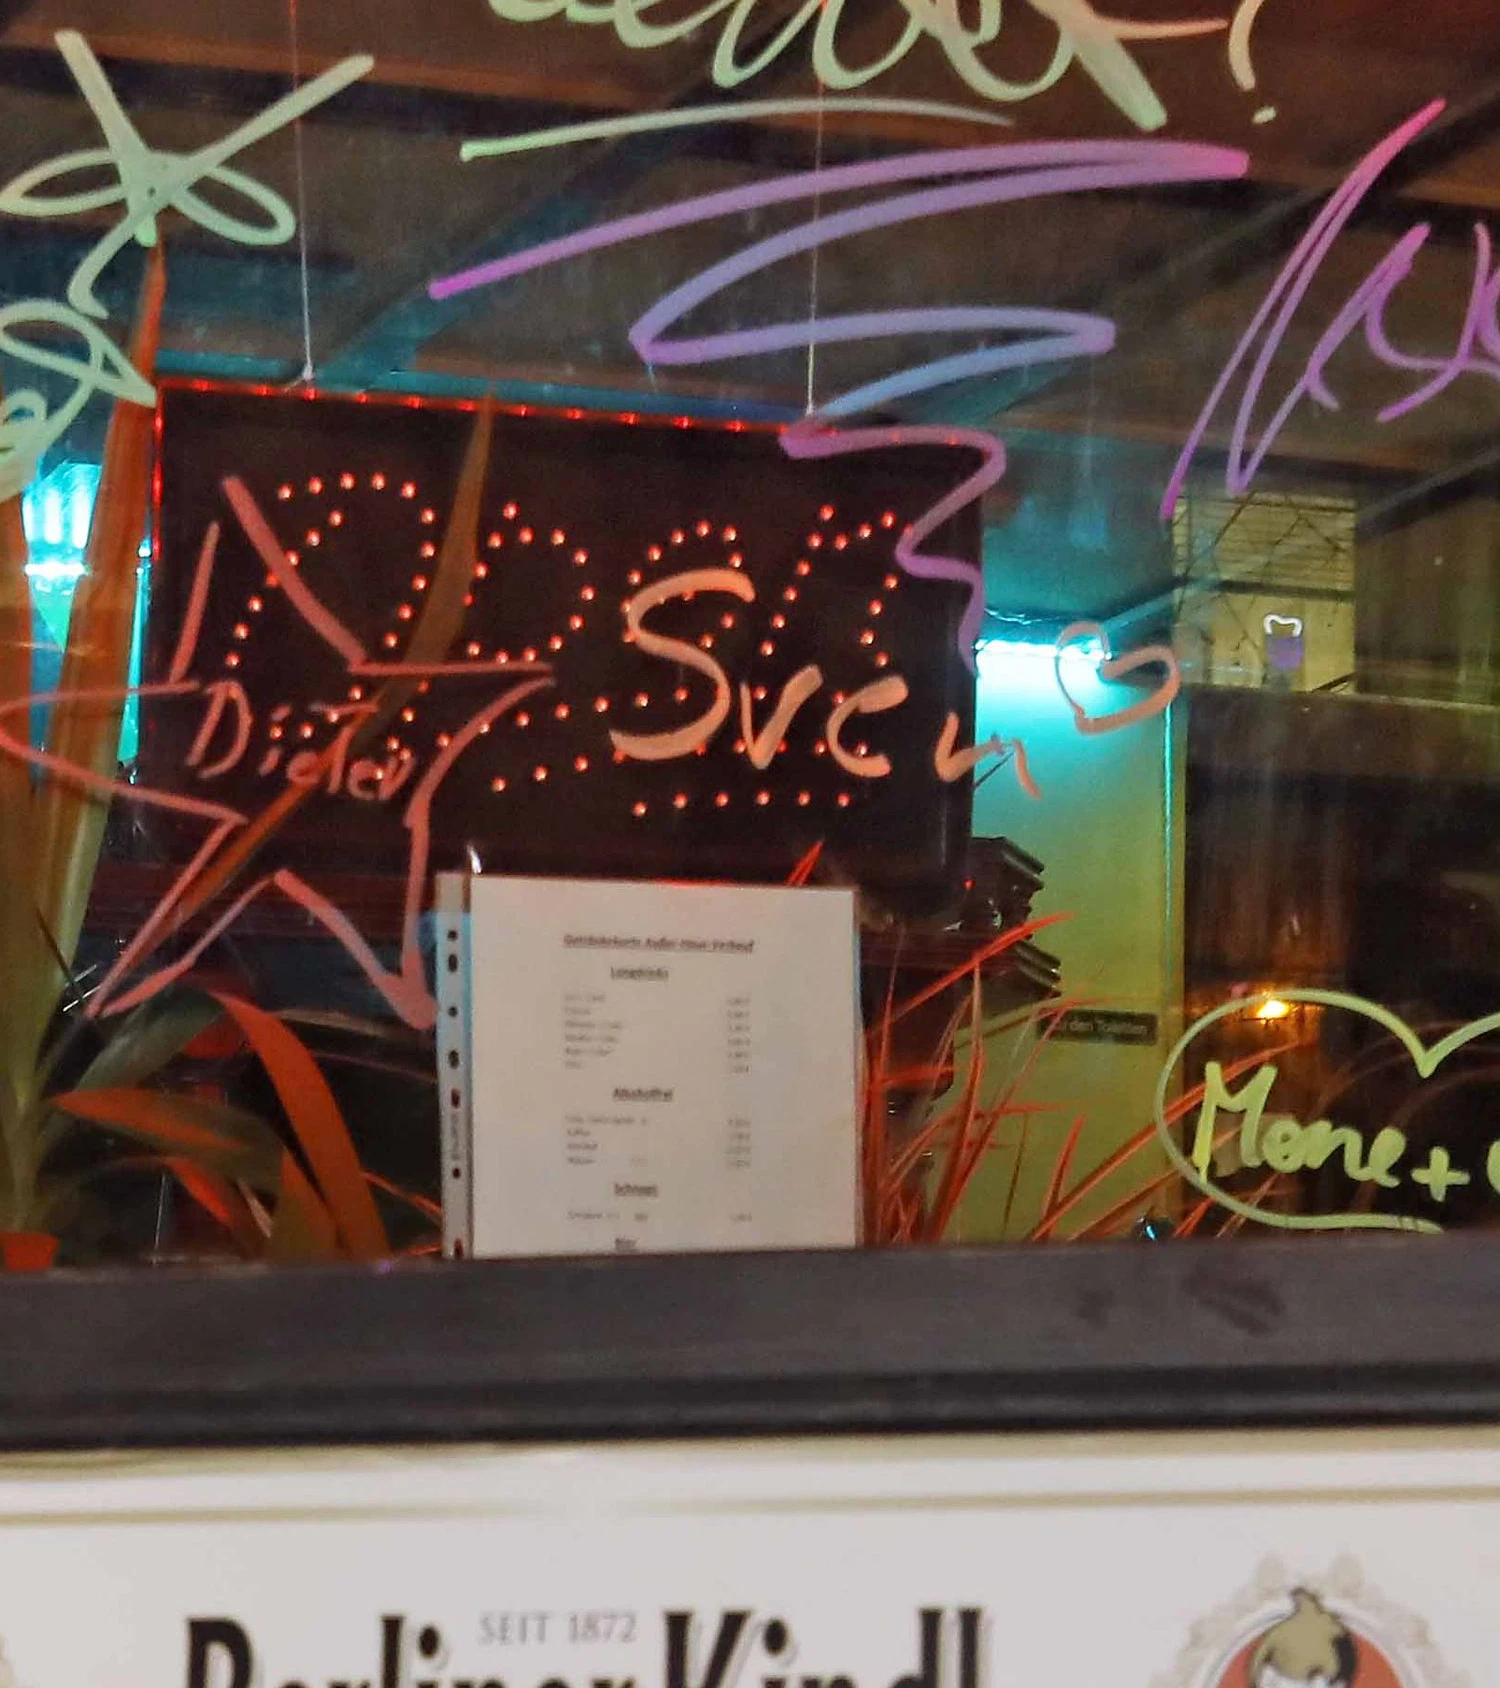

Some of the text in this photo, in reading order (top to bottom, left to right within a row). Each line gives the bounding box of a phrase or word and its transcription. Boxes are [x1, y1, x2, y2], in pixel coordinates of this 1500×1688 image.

[187, 680, 415, 800] Dieter
[609, 567, 1043, 800] Sven
[477, 1608, 638, 1646] SEIT 1872
